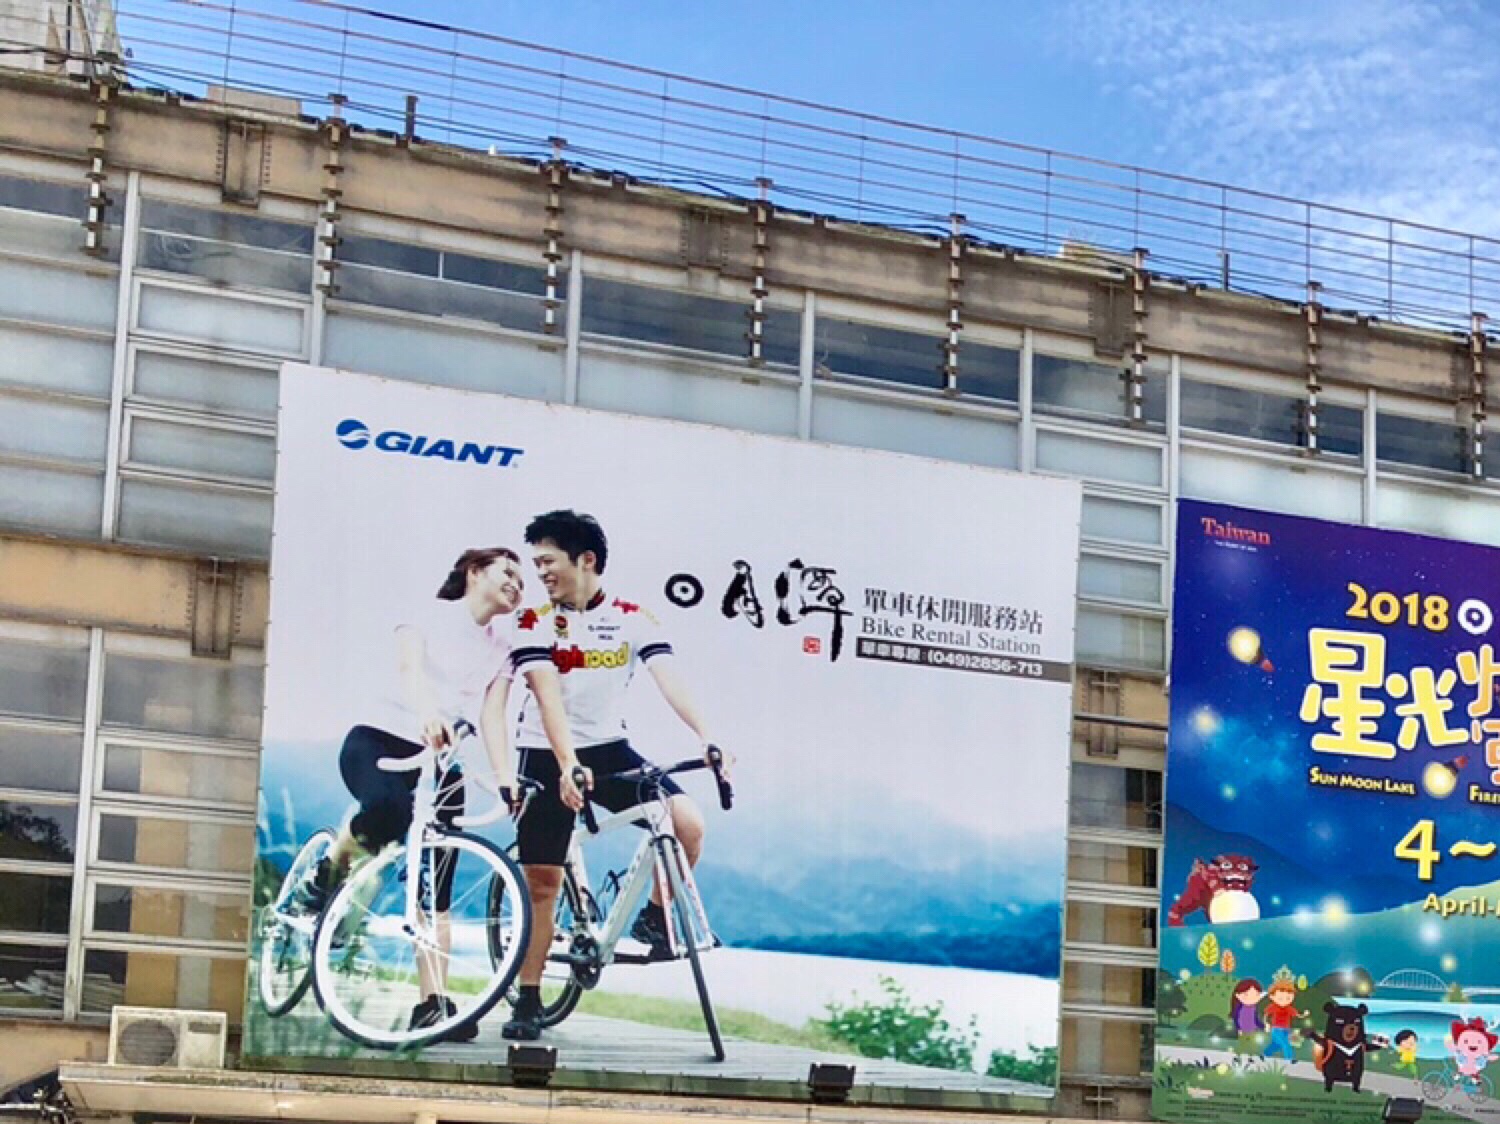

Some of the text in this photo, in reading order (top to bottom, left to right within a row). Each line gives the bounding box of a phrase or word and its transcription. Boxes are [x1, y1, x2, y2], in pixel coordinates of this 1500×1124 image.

[374, 430, 524, 467] GIANT
[1201, 517, 1270, 545] Taiwan
[1346, 582, 1449, 632] 2018
[862, 615, 1041, 655] Bike Rental Station
